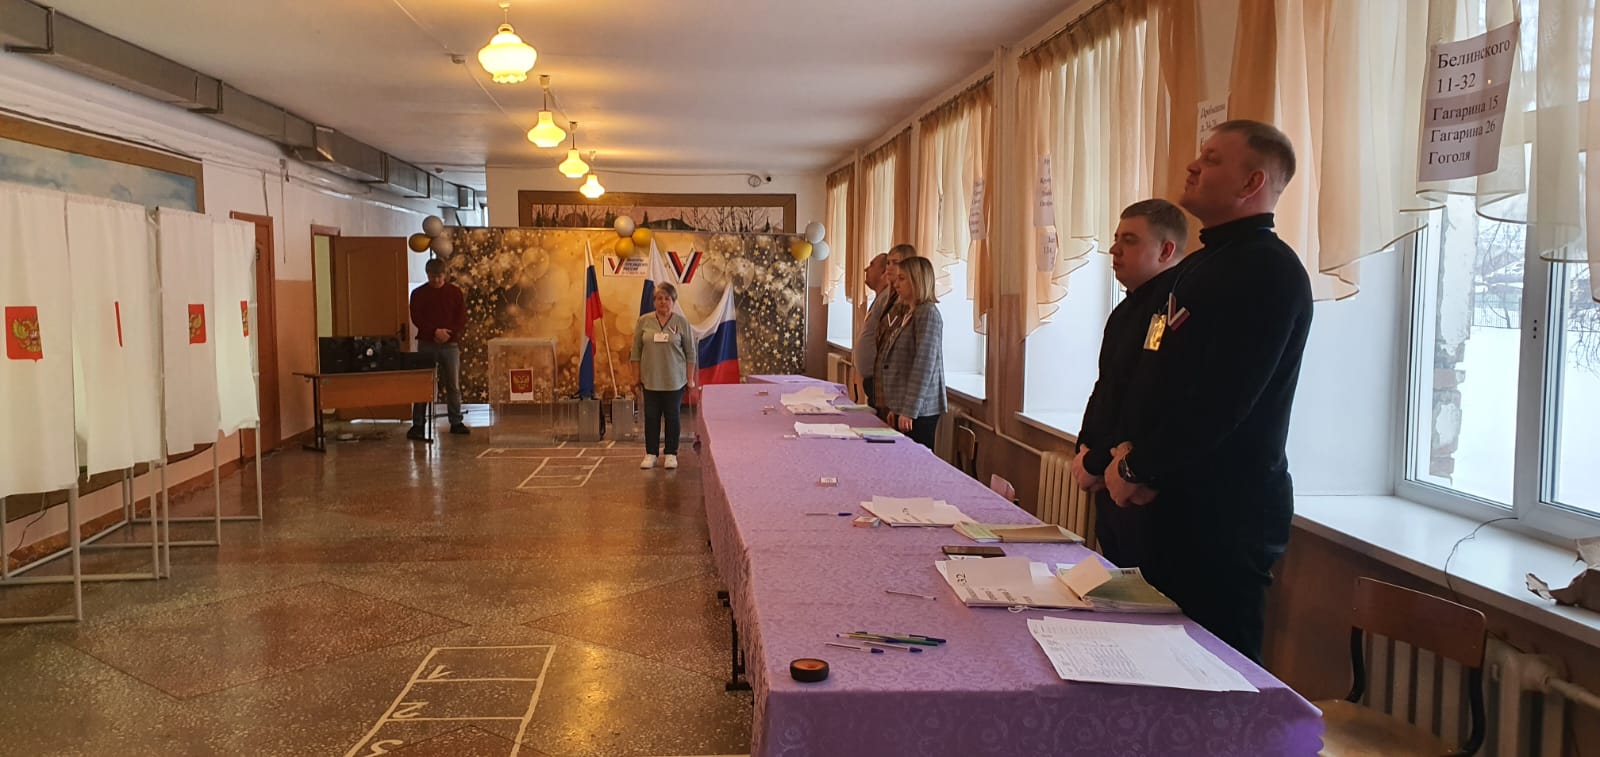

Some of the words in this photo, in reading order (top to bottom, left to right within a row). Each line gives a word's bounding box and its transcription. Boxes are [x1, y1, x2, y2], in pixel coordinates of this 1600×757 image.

[1437, 39, 1511, 69] Белинского
[1437, 72, 1476, 93] 11-32
[1432, 101, 1486, 121] Гагарина
[1489, 95, 1499, 111] 15
[1430, 124, 1483, 143] Гагарина
[1485, 119, 1496, 134] 26
[1428, 150, 1471, 165] Гоголя
